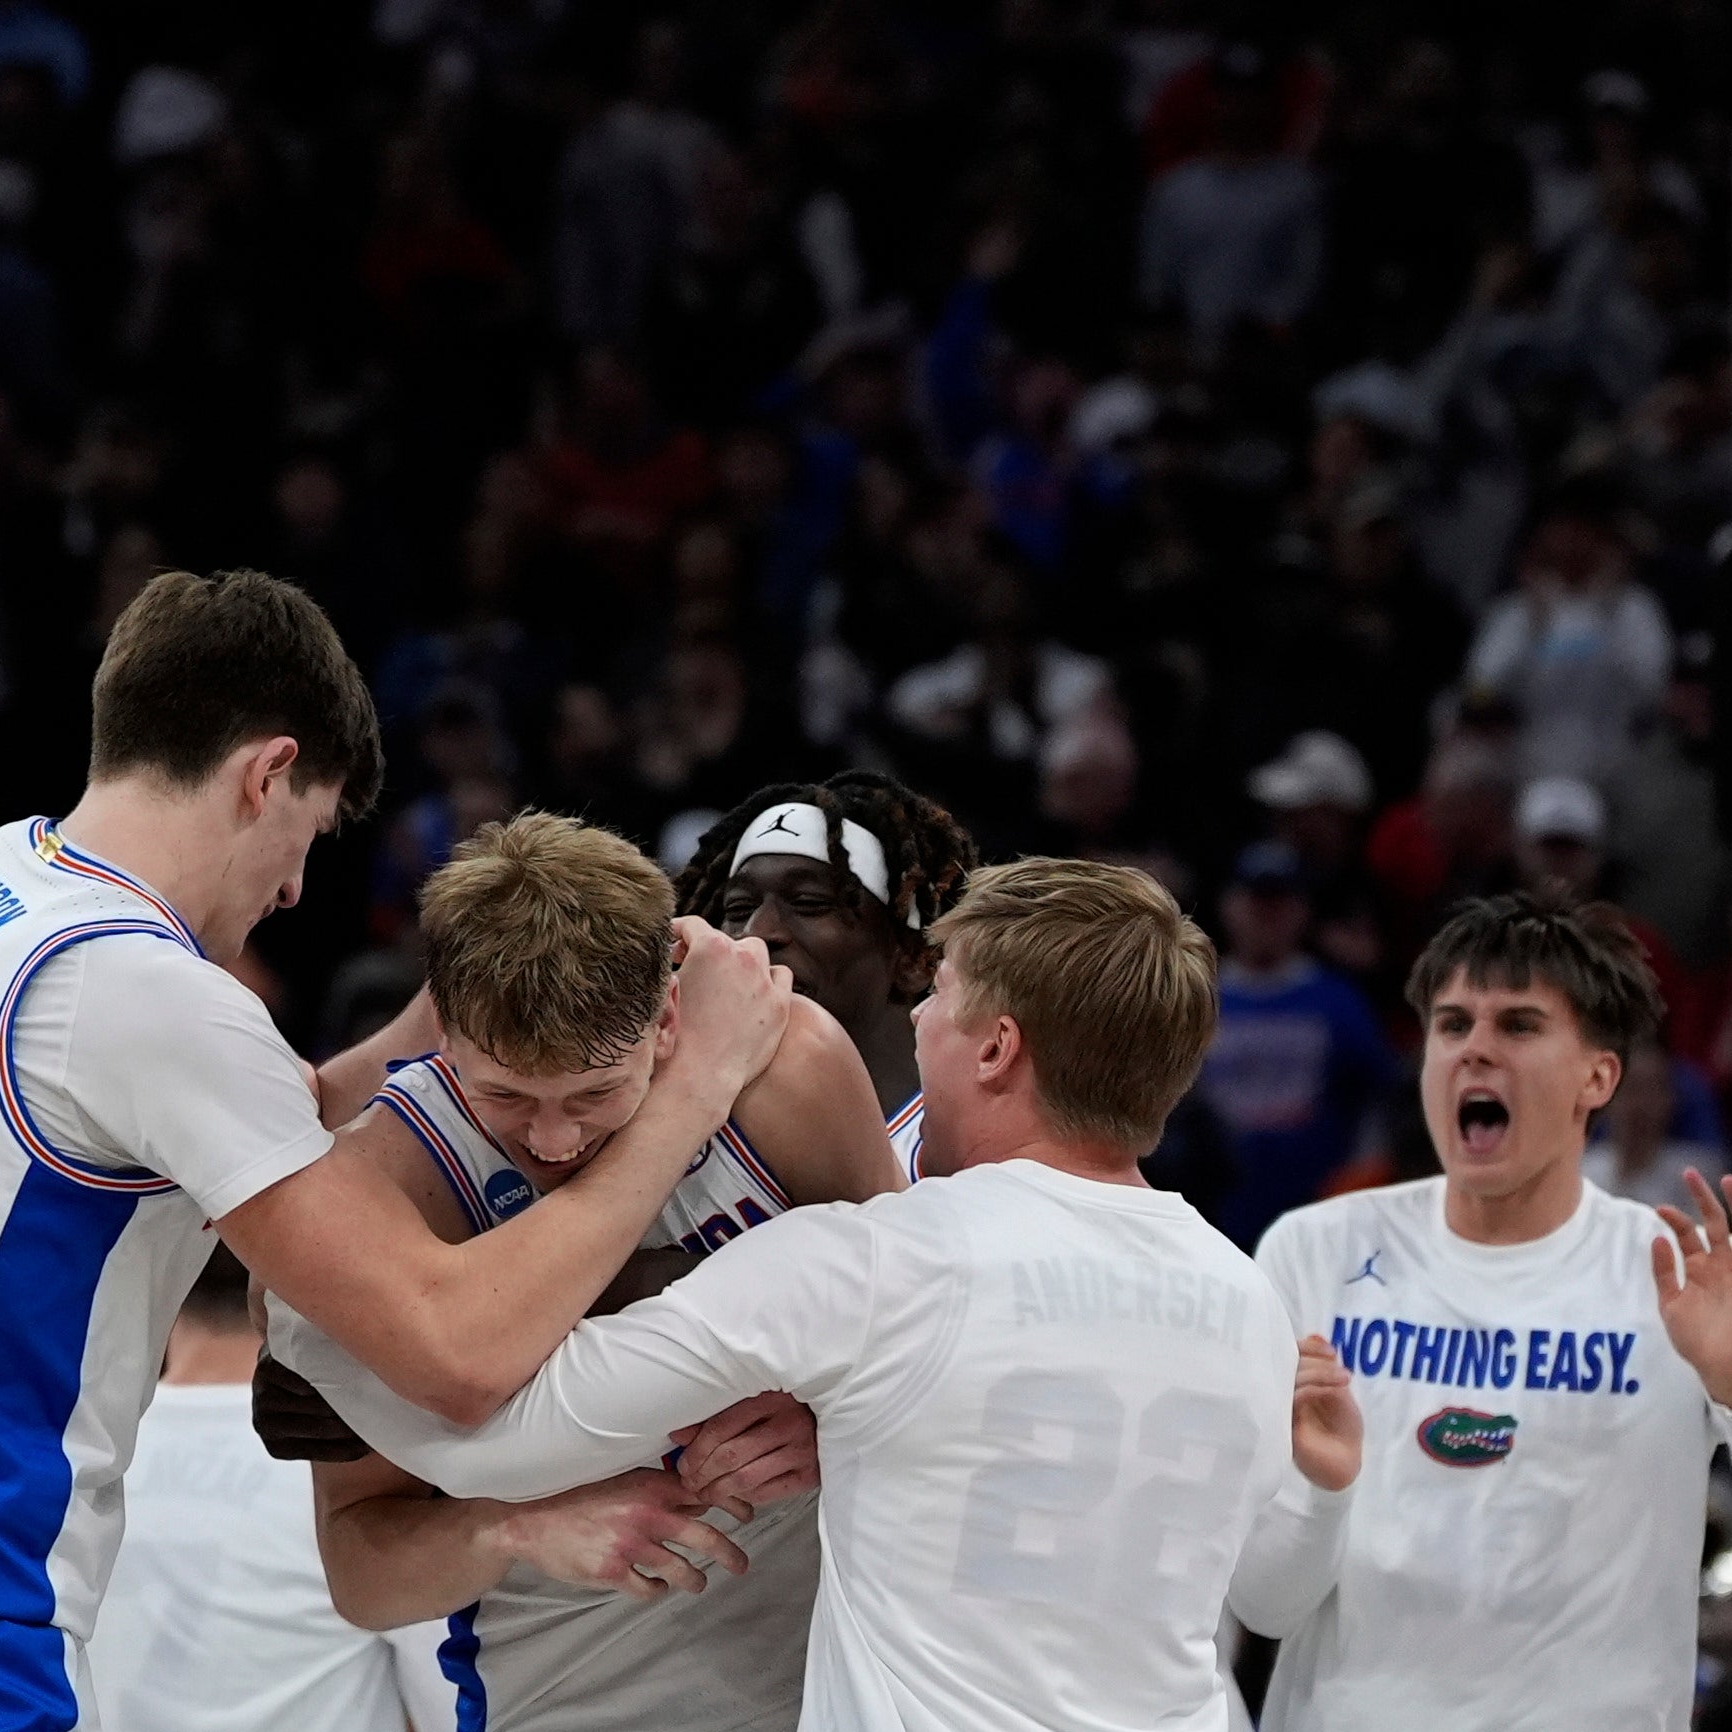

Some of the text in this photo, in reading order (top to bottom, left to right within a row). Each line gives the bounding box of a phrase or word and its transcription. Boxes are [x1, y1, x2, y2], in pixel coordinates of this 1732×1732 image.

[492, 1182, 532, 1212] NCAA
[1332, 1317, 1640, 1395] NOTHING EASY.
